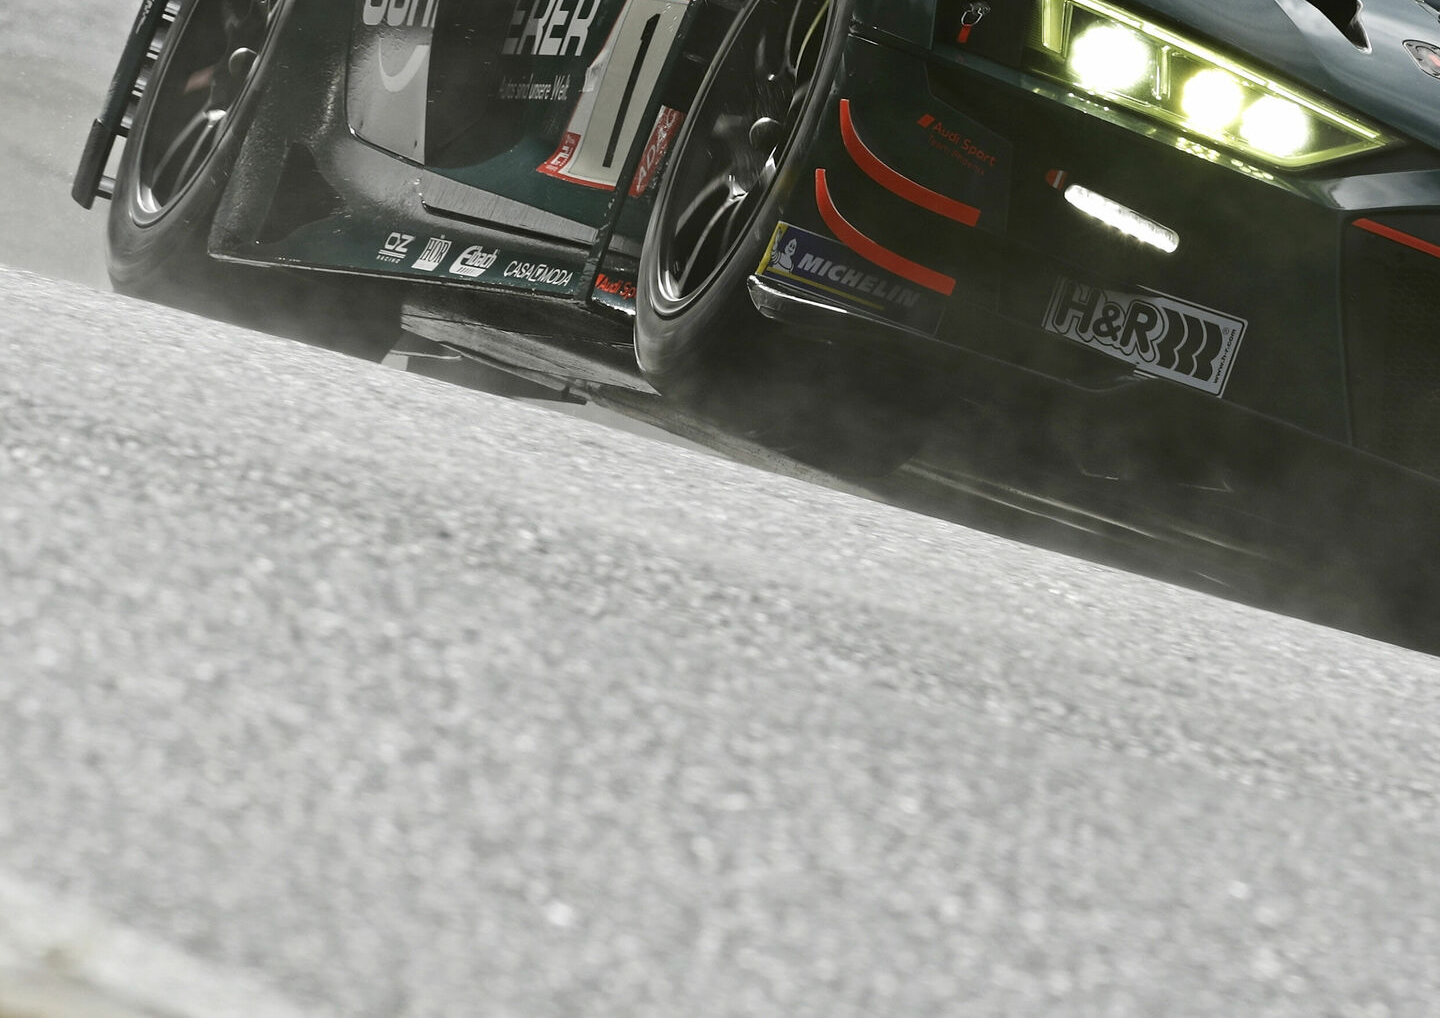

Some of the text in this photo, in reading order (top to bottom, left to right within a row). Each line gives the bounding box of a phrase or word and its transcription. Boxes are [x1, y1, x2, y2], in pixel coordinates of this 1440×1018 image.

[602, 13, 661, 169] 1
[933, 122, 998, 166] Audi Sport
[384, 231, 416, 253] OZ
[798, 253, 921, 307] MICHELIN
[1054, 282, 1160, 364] H&R
